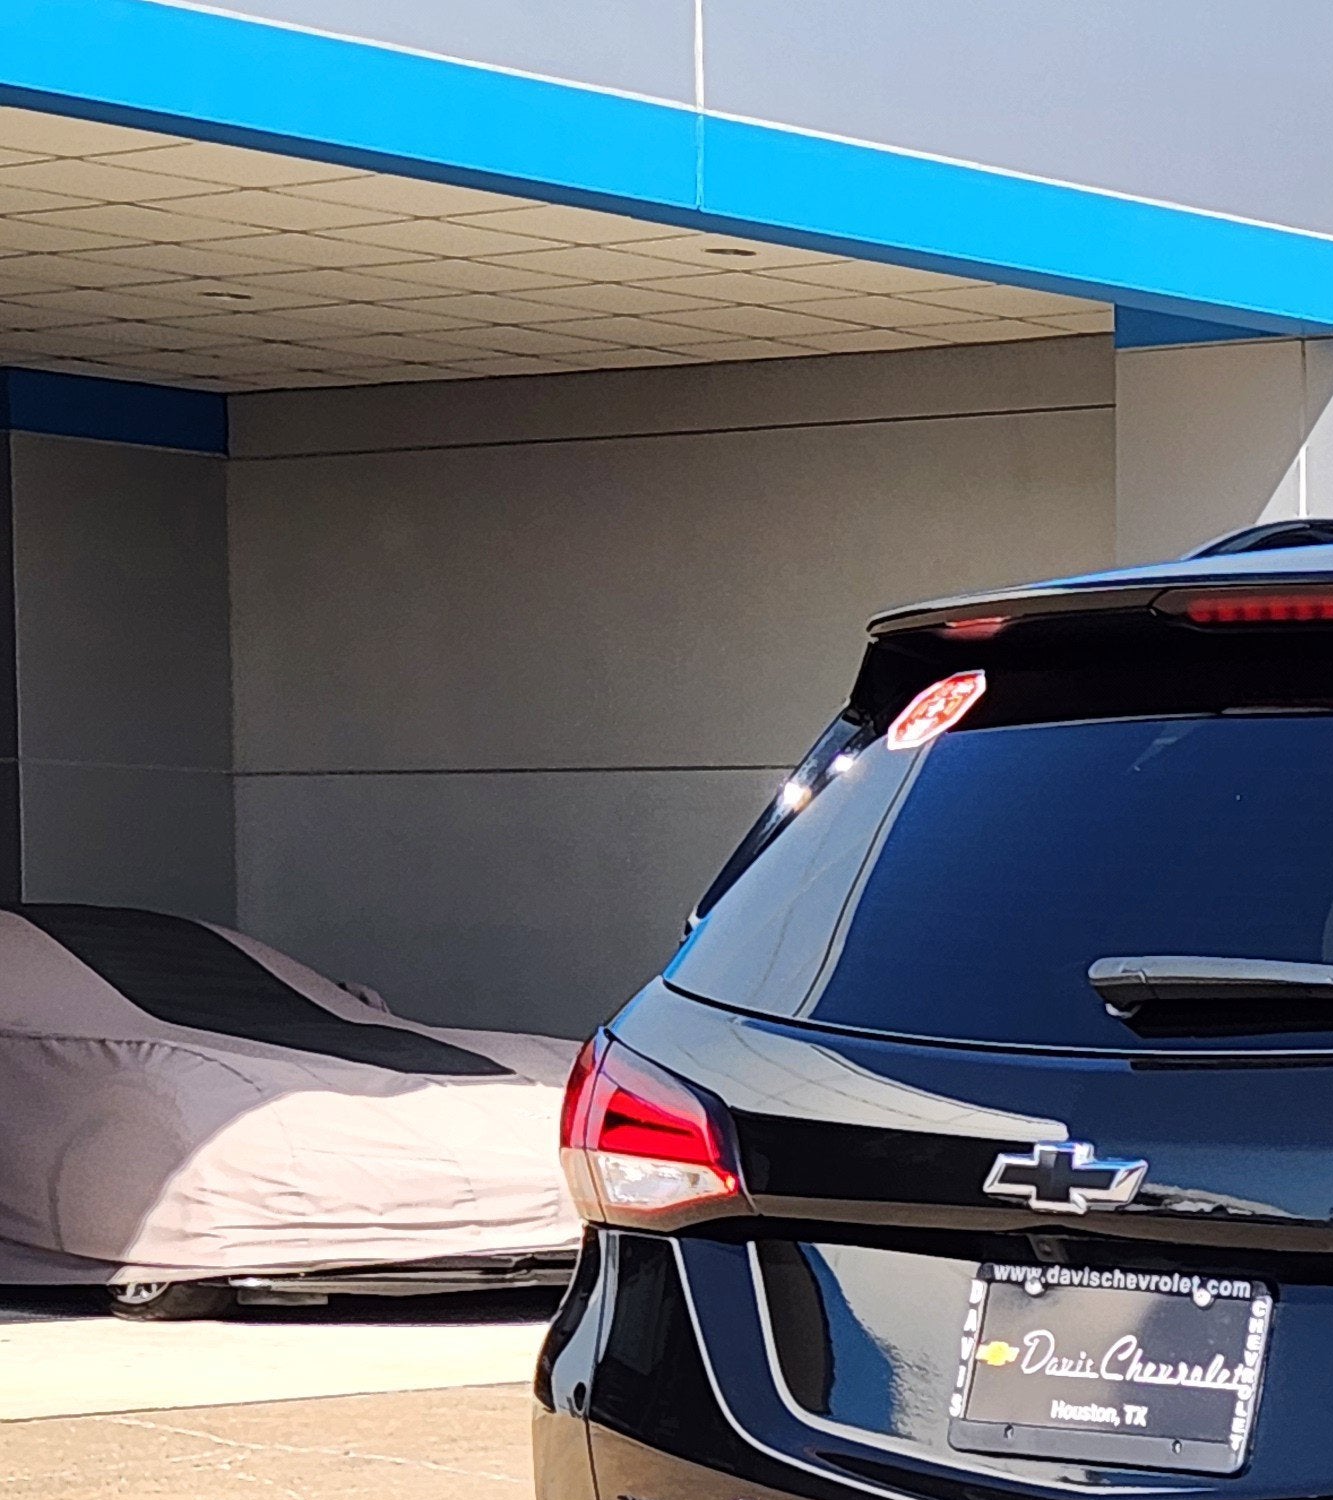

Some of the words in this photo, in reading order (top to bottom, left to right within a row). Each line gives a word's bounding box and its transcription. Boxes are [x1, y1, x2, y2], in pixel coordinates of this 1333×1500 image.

[993, 1265, 1251, 1298] www.davischevroletcom
[1021, 1329, 1099, 1379] Davis
[1101, 1334, 1251, 1390] Chevrolet
[1050, 1400, 1120, 1426] Houston,
[1123, 1403, 1148, 1427] TX
